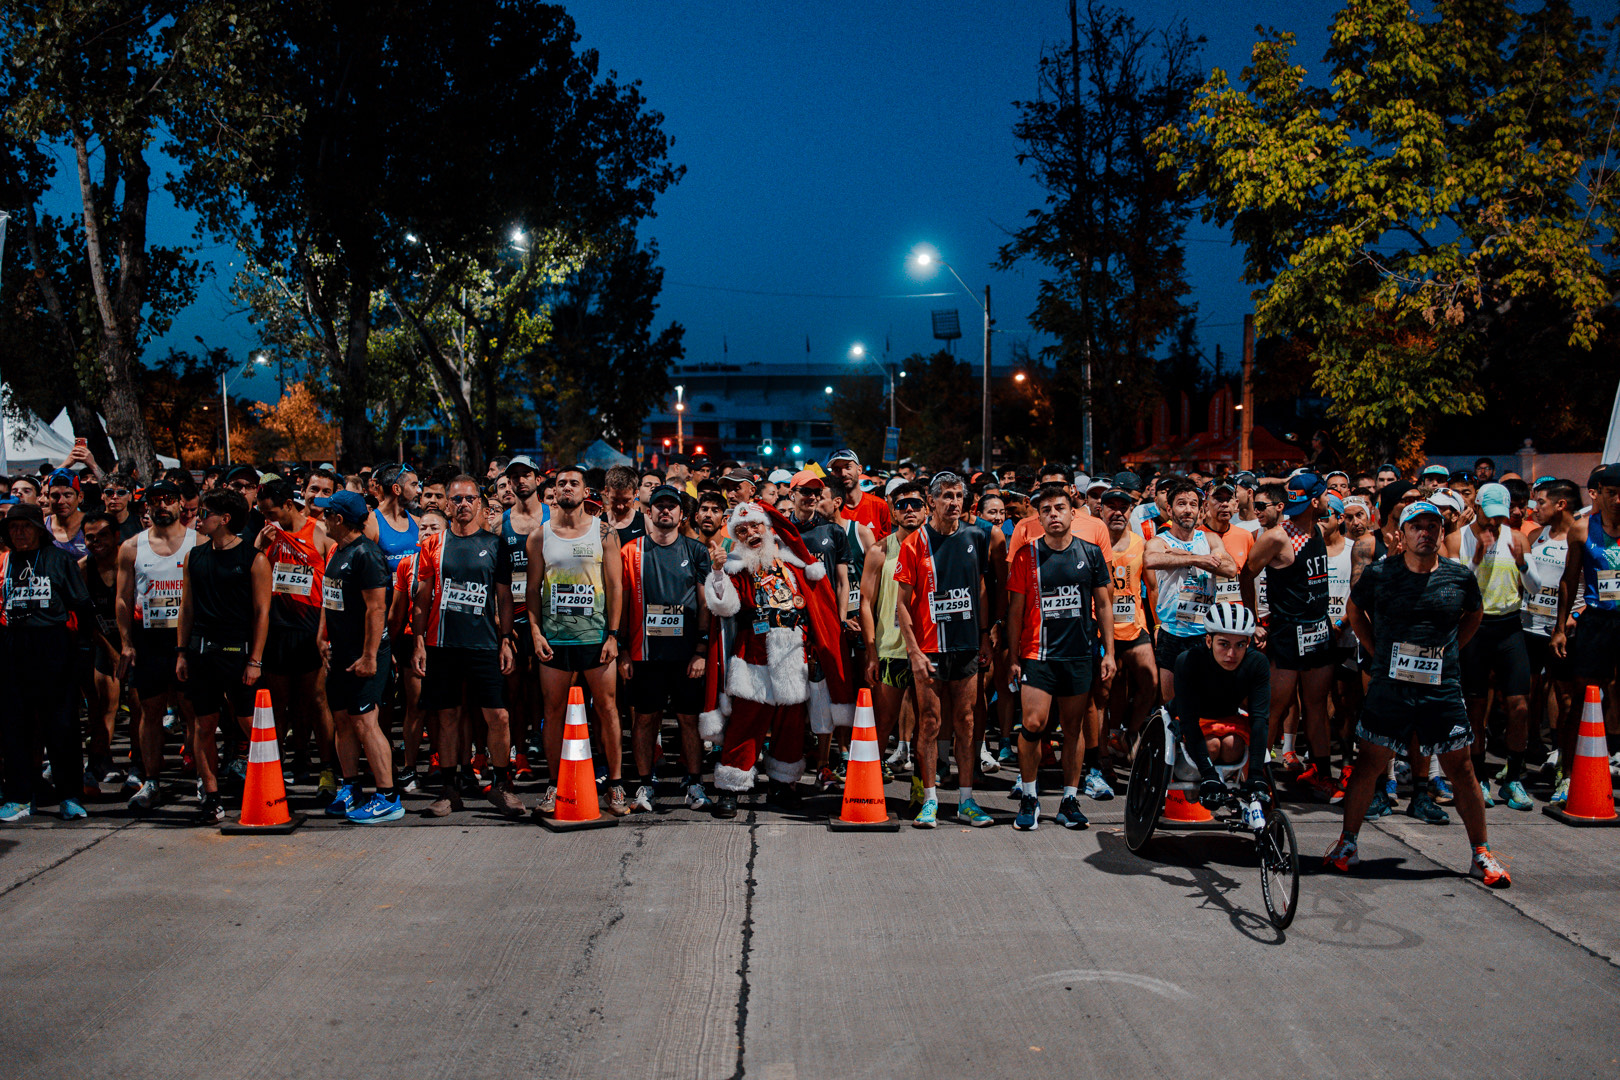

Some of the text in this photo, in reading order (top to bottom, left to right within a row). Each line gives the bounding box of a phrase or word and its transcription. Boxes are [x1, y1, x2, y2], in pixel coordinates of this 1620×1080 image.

[1306, 554, 1328, 577] SFT
[276, 573, 308, 584] M 554
[466, 581, 488, 594] 10K
[513, 583, 521, 592] M
[572, 584, 595, 595] 10K
[1056, 584, 1080, 597] 10K
[448, 591, 485, 604] M 2436
[948, 587, 971, 600] 10K
[557, 595, 593, 605] M 2809
[1043, 597, 1078, 609] M 2134
[1117, 595, 1136, 604] 21K
[1538, 596, 1557, 606] 569
[663, 604, 684, 615] 21K
[935, 599, 970, 612] M 2598
[1116, 605, 1131, 613] 130
[1178, 602, 1188, 611] M
[150, 609, 159, 618] M
[647, 616, 680, 625] M 508
[1303, 636, 1311, 644] M
[1419, 646, 1443, 659] 21K
[1398, 657, 1439, 671] M 1232
